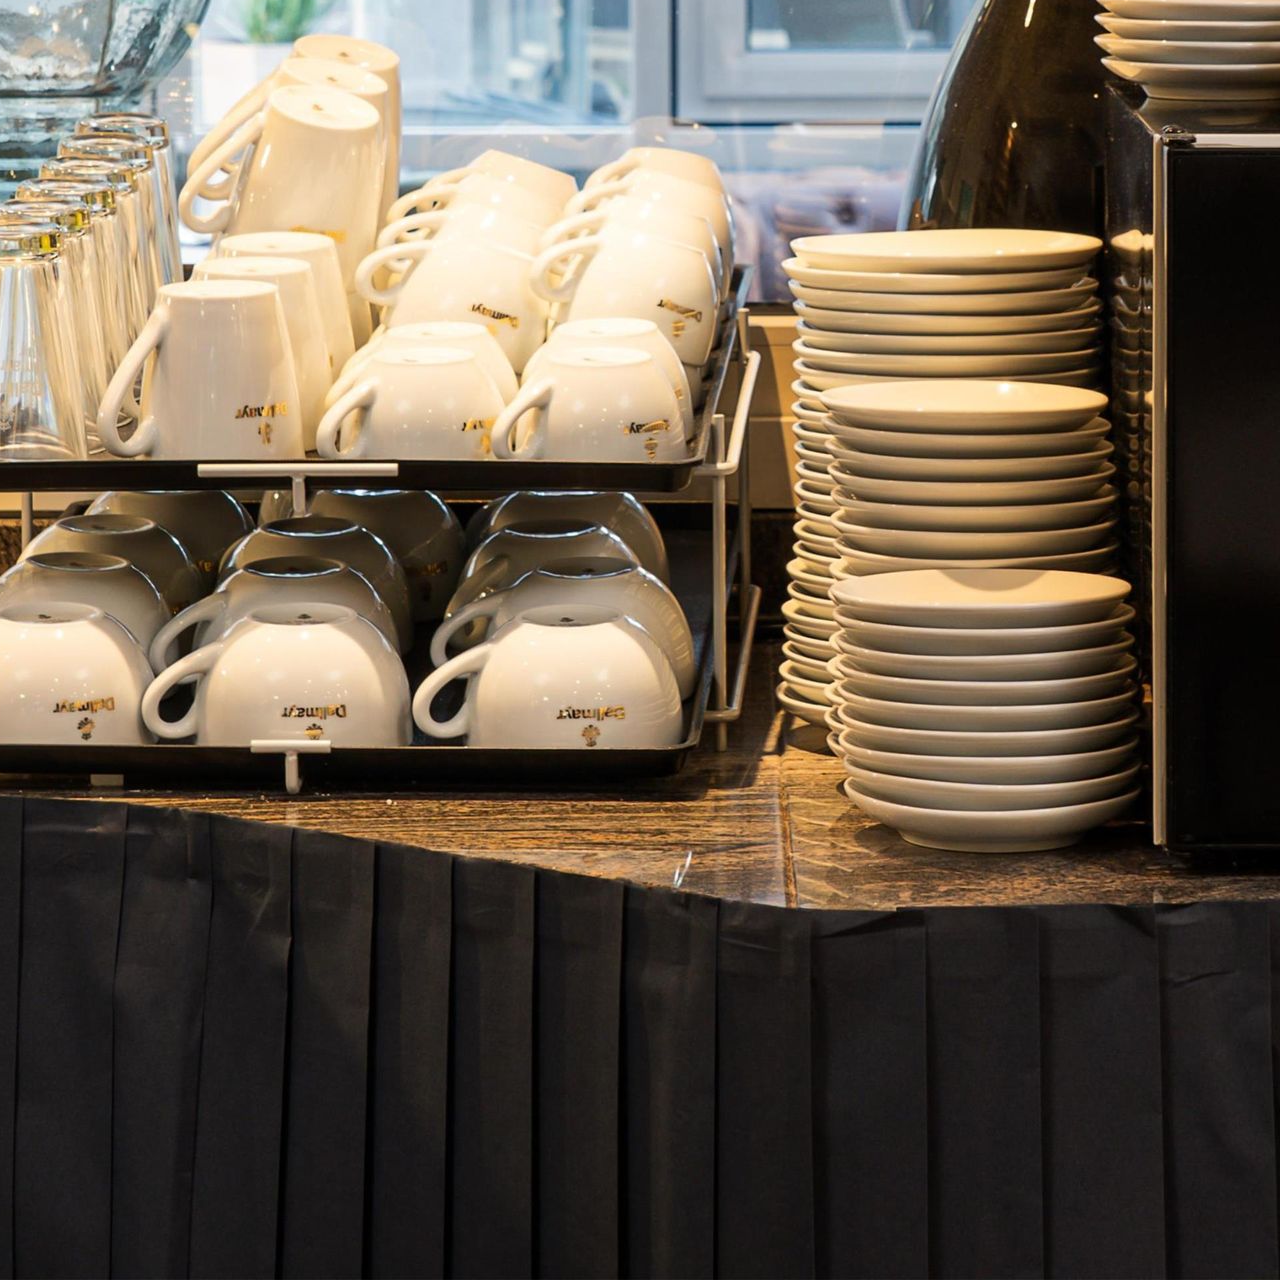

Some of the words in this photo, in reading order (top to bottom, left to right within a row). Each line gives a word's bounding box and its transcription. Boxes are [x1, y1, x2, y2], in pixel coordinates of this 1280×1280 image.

[53, 697, 115, 714] Dallmayr
[281, 703, 347, 720] Dallmayr
[556, 706, 625, 721] Dallmayr
